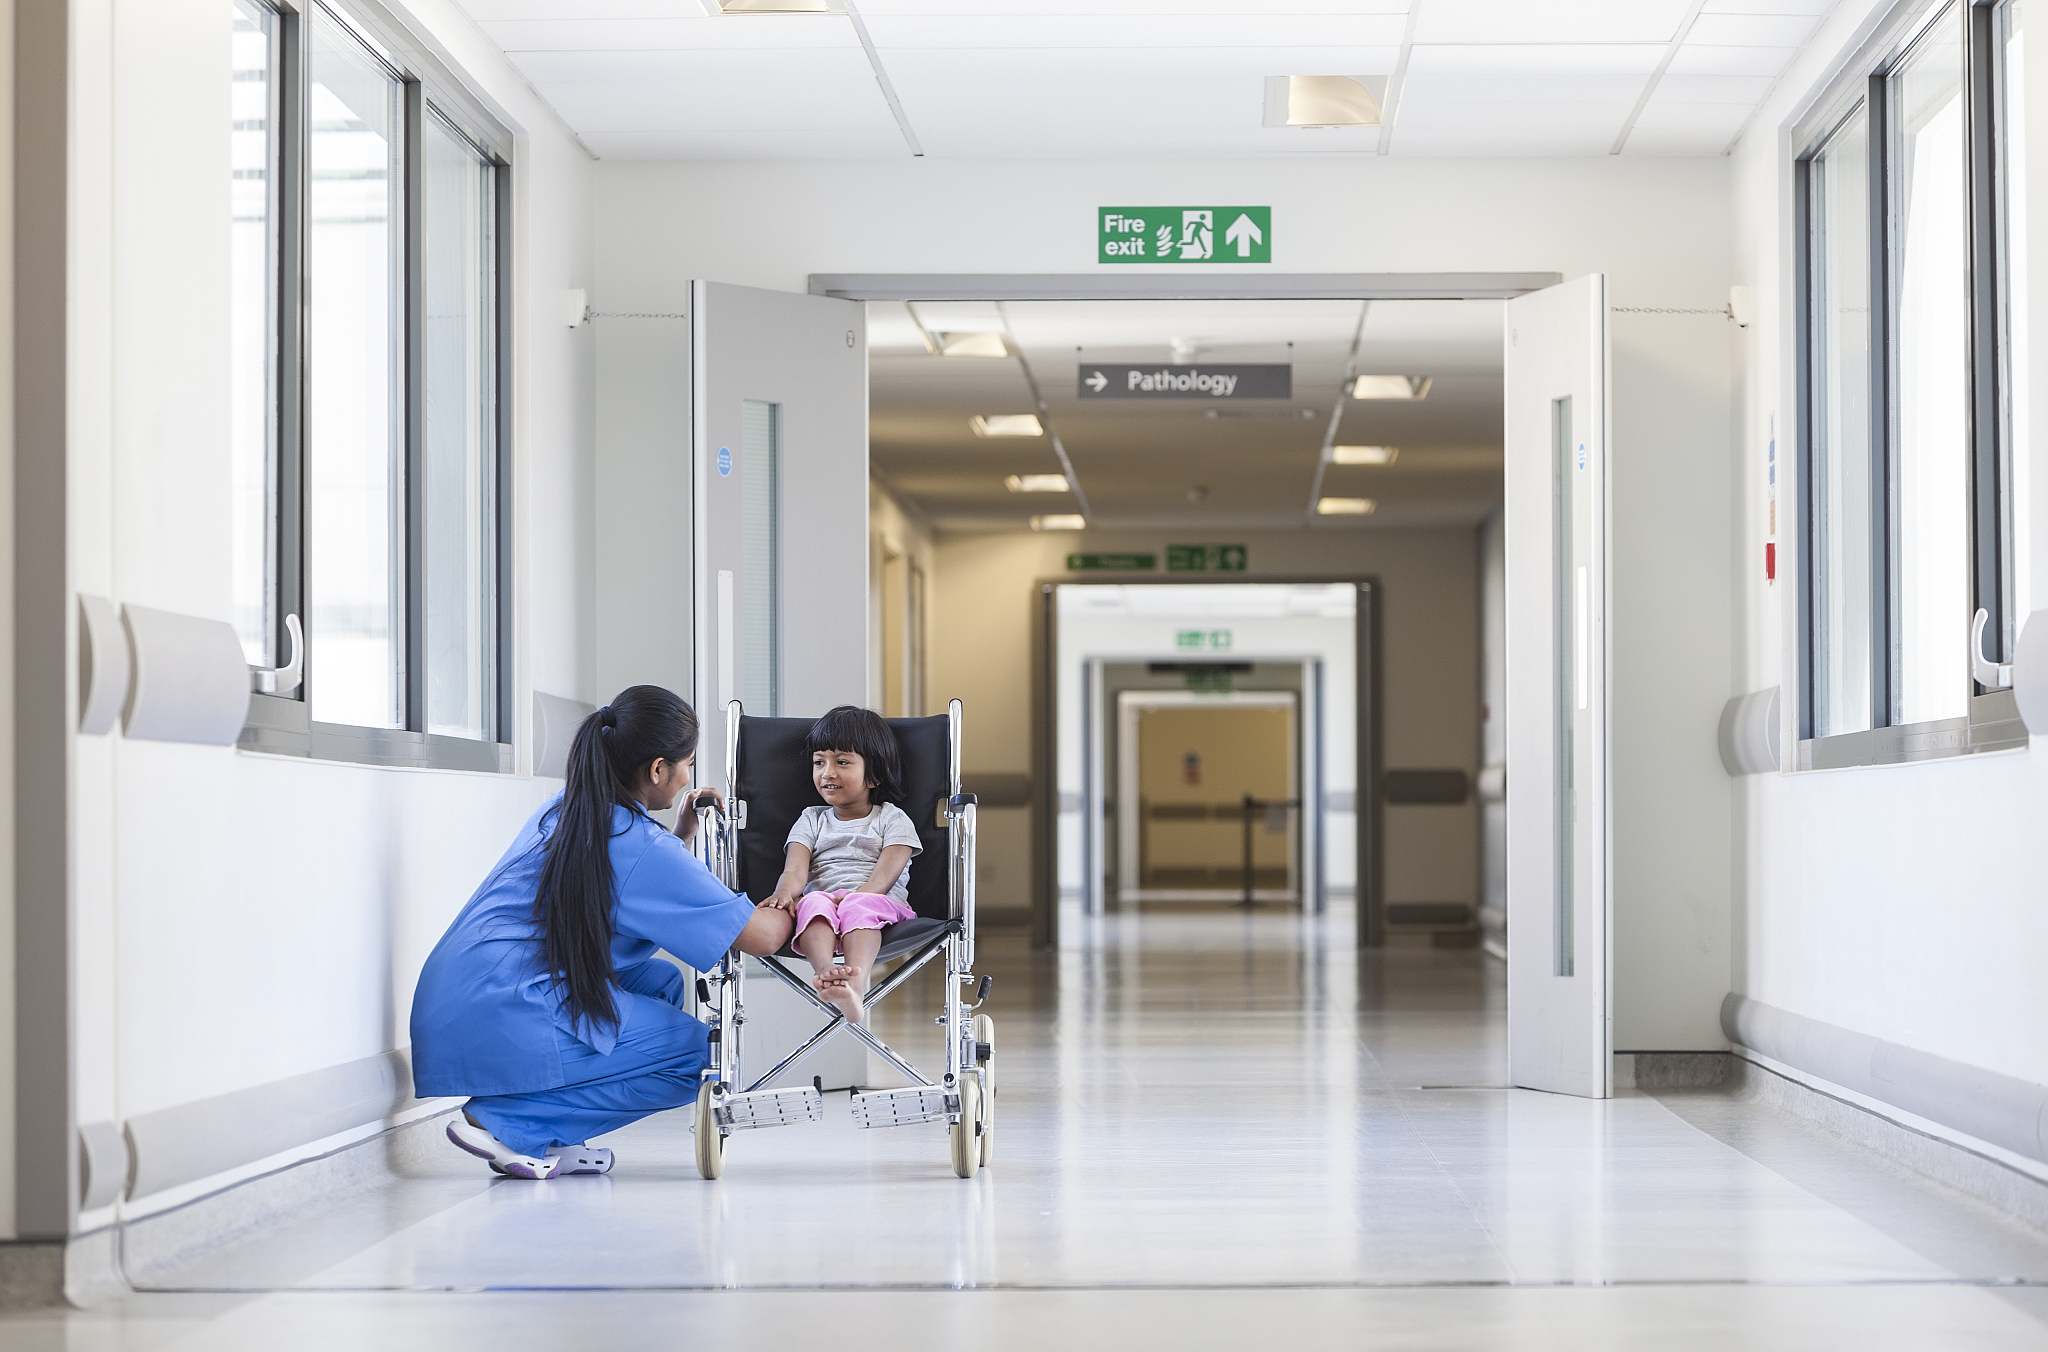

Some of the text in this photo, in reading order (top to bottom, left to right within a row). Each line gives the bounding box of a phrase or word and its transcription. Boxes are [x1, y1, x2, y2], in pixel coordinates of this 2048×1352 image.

[1104, 214, 1146, 233] Fire
[1104, 237, 1146, 256] exit
[1127, 369, 1238, 396] Pathology
